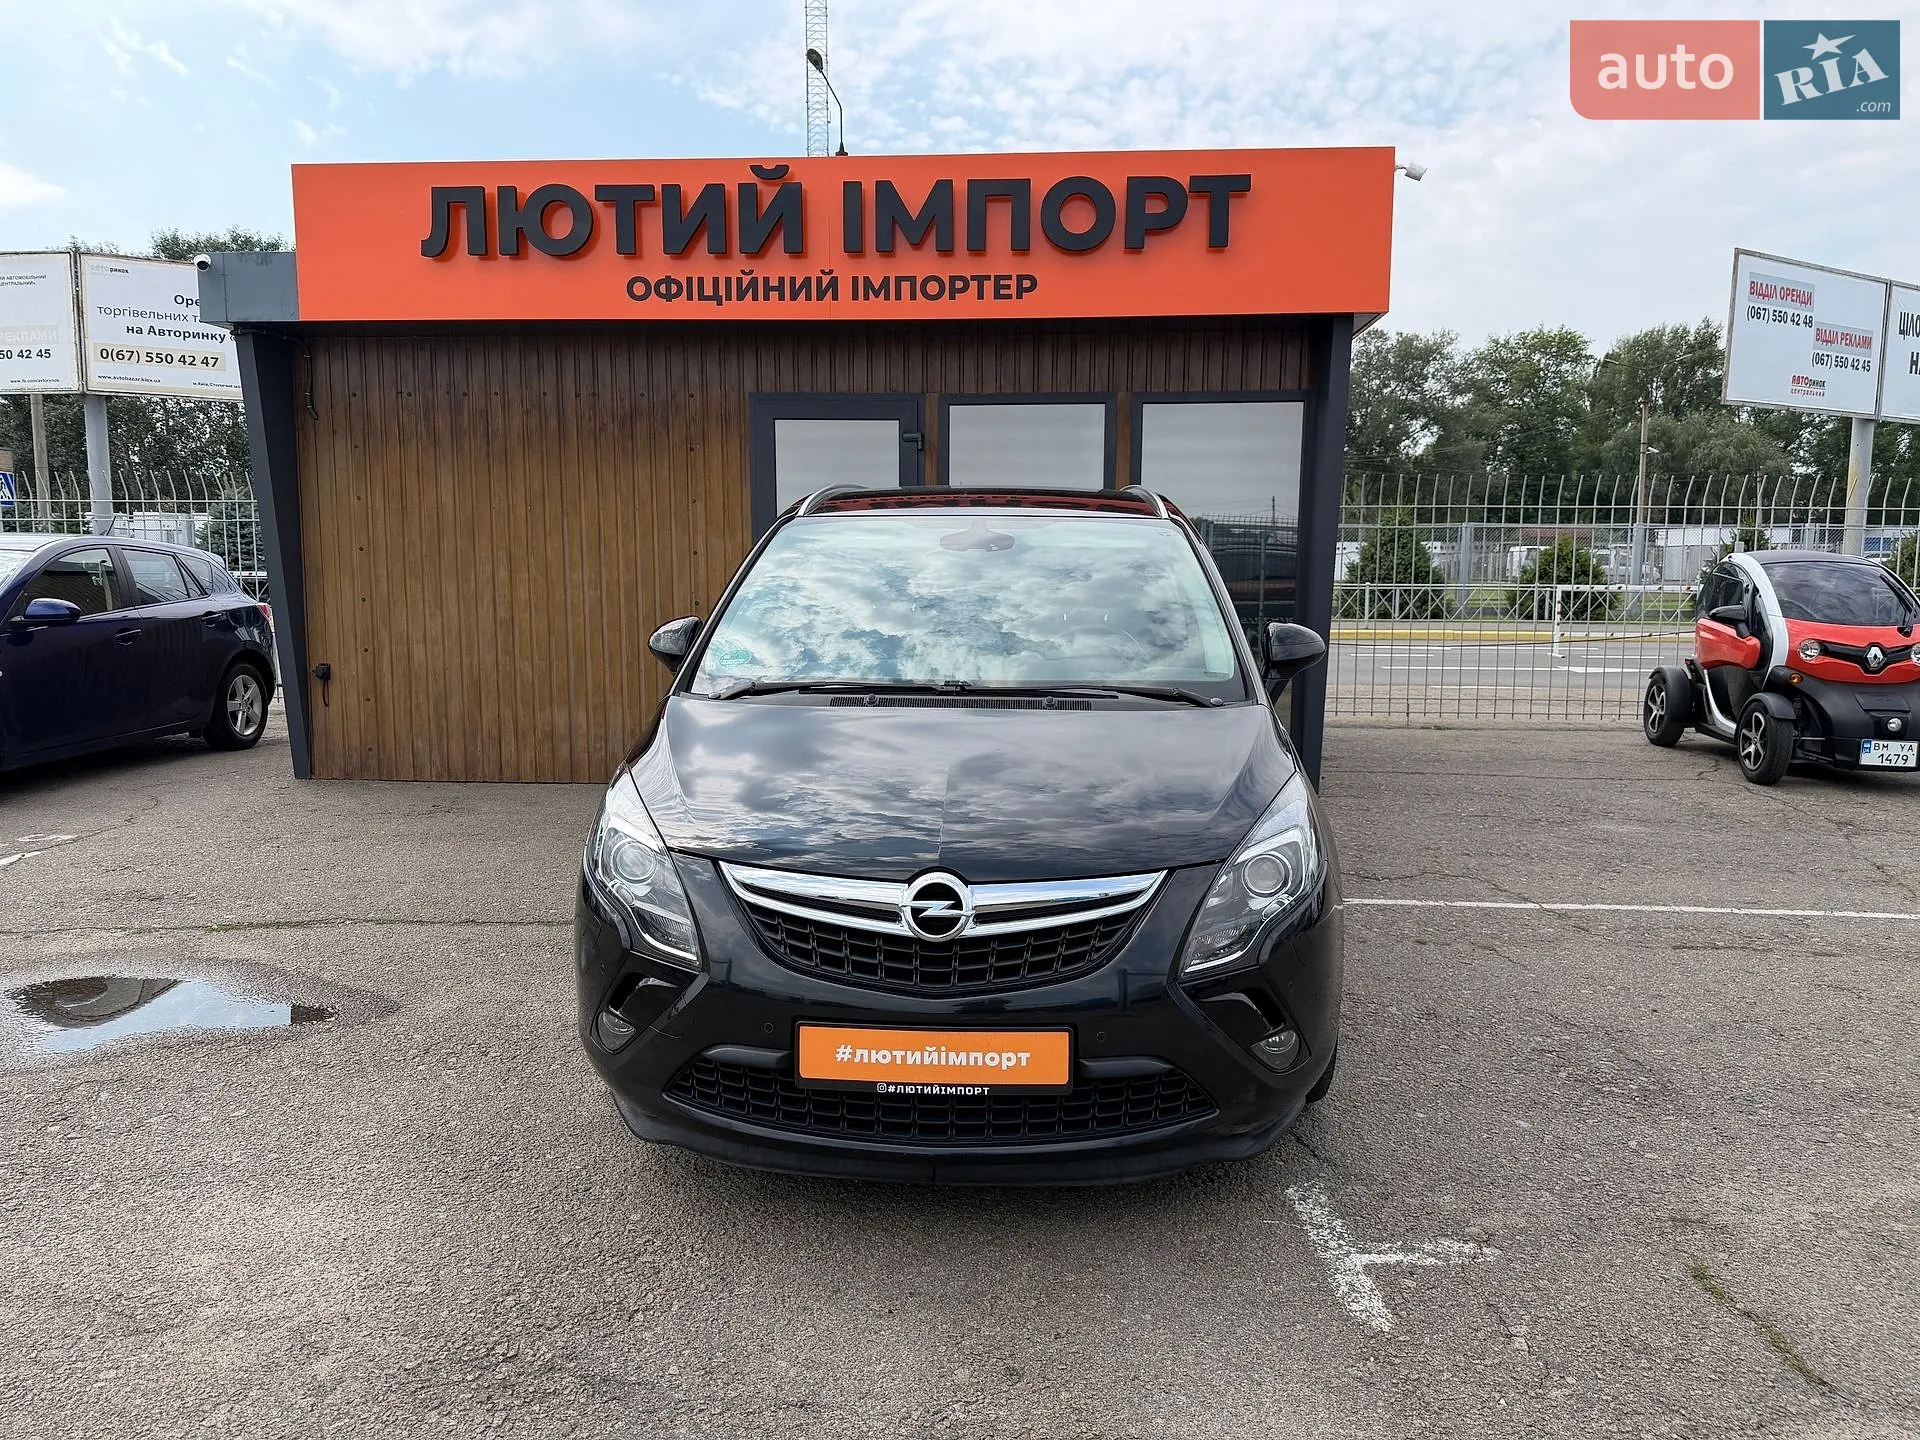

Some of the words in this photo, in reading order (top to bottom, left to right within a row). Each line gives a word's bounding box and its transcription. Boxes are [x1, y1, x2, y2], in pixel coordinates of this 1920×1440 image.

[420, 164, 804, 258] ЛЮТИЙ
[842, 174, 1252, 255] ІМПОРТ
[626, 269, 834, 306] ОФІЦІЙНИЙ
[851, 273, 1038, 302] ІМПОРТЕР
[1749, 280, 1778, 301] ВІДДІЛ
[1779, 285, 1813, 308] ОРЕНДИ
[97, 305, 189, 323] торгівельних
[1746, 304, 1770, 324] (067)
[1771, 308, 1788, 324] 550
[1790, 312, 1801, 326] 42
[1802, 314, 1814, 329] 48
[126, 325, 144, 335] на
[147, 325, 227, 344] Авторинку
[1815, 327, 1839, 347] ВІДДІЛ
[1840, 331, 1872, 350] РЕКЛАМИ
[17, 348, 33, 359] 42
[36, 348, 52, 359] 45
[99, 348, 141, 364] 0(67)
[145, 351, 174, 365] 550
[177, 354, 197, 367] 42
[200, 356, 219, 368] 47
[1811, 351, 1833, 370] (067)
[1834, 355, 1849, 369] 550
[1850, 357, 1861, 371] 42
[1861, 359, 1872, 373] 45
[1873, 742, 1889, 751] BM
[1899, 743, 1914, 753] YA
[1877, 753, 1909, 765] 1479
[835, 1044, 1031, 1070] #лютийімпорт
[887, 1084, 990, 1096] #ЛЮТИЙІМПОРТ
